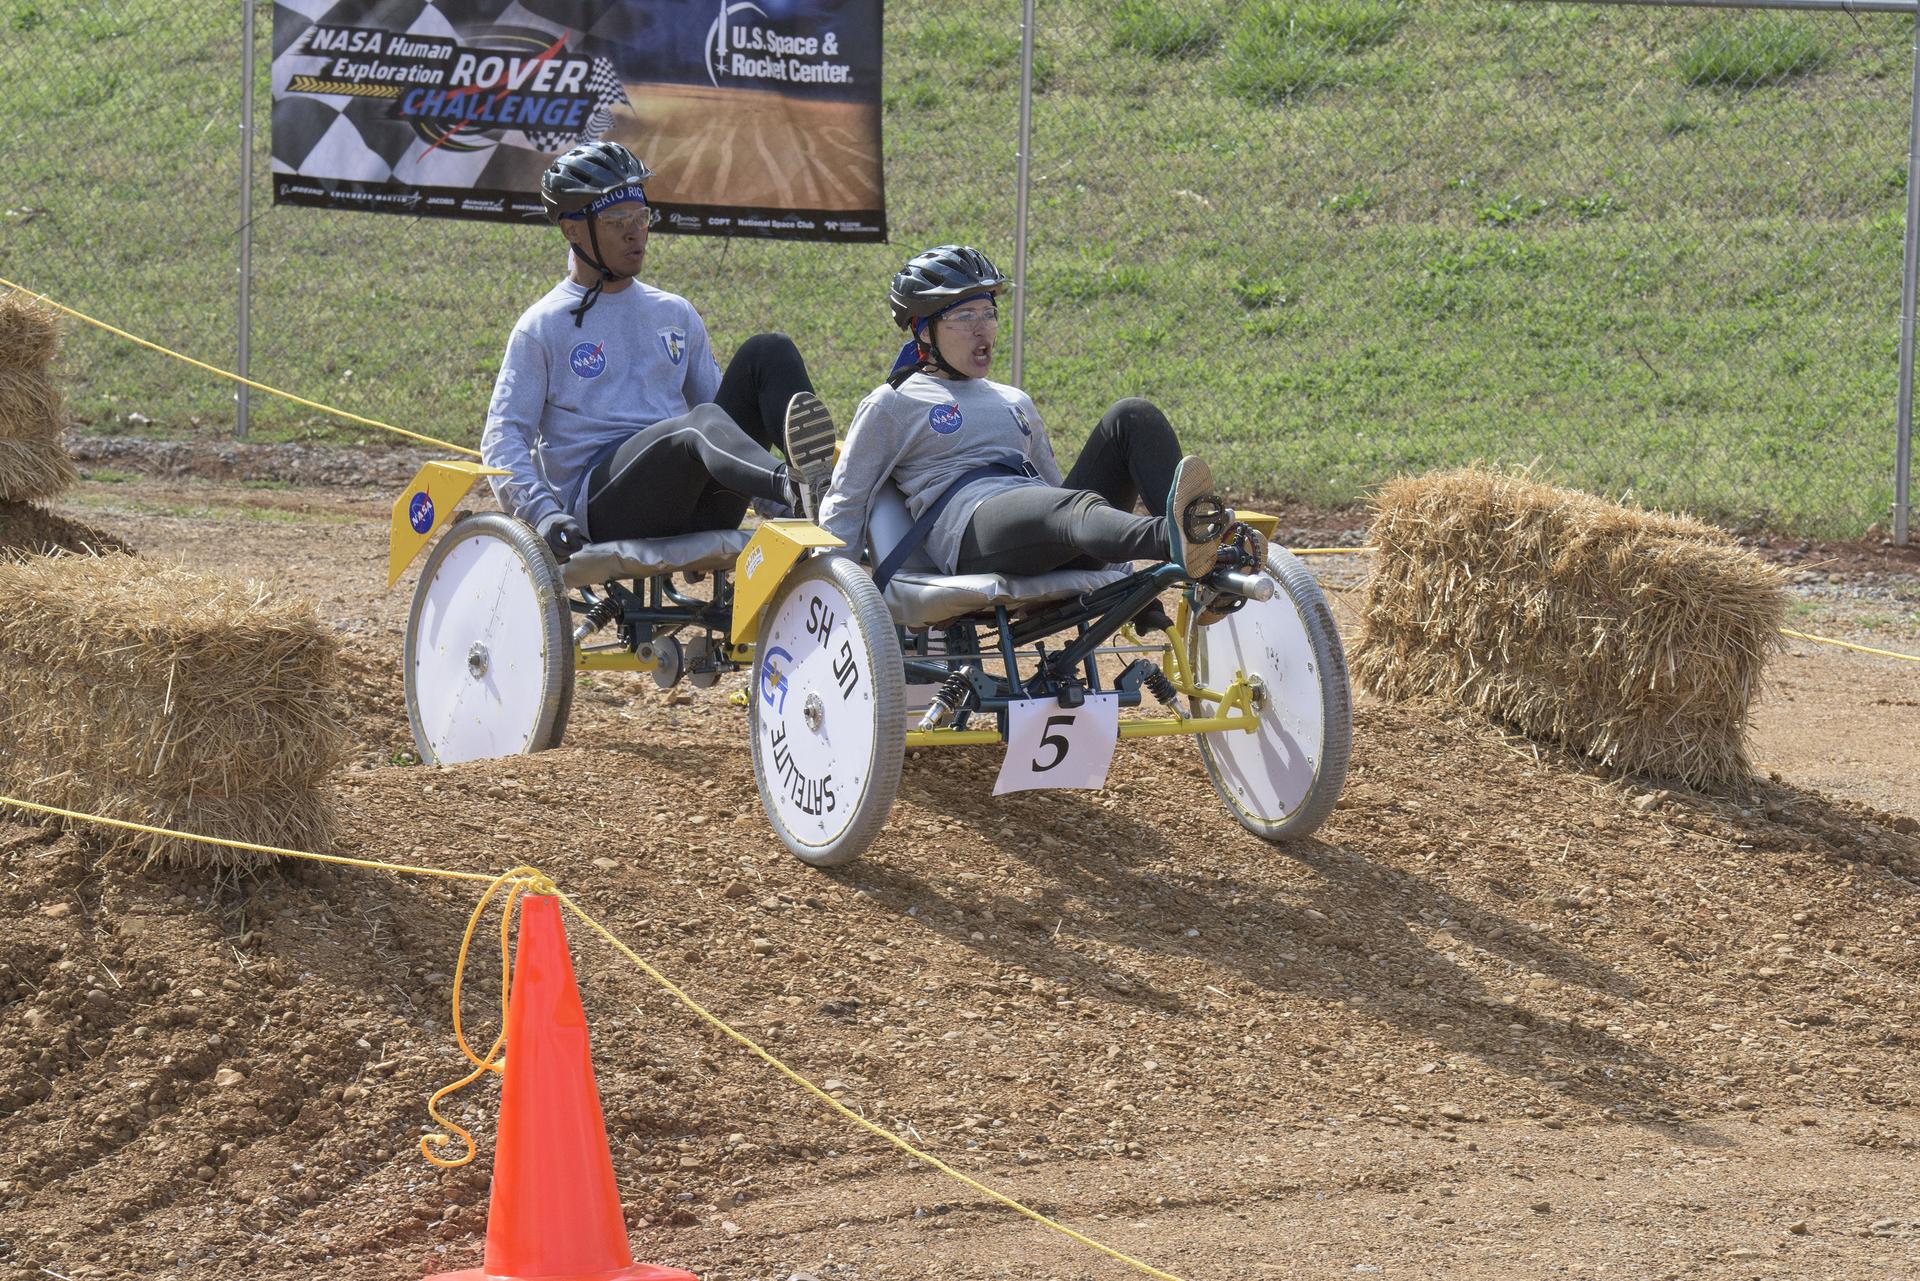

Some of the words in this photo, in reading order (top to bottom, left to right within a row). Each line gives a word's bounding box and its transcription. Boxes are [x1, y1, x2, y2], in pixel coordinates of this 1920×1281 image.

[310, 28, 384, 54] NASA
[386, 37, 453, 60] Human
[766, 30, 819, 58] Space
[822, 32, 839, 56] &
[332, 58, 445, 84] Exploration
[450, 54, 588, 93] ROVER
[732, 53, 788, 80] Rocket
[402, 88, 588, 126] CHALLENGE
[738, 218, 770, 228] National
[771, 219, 795, 230] Space
[796, 220, 815, 230] Club
[574, 353, 604, 369] NASA
[931, 411, 961, 426] NASA
[411, 500, 433, 527] NASA
[833, 640, 859, 700] UG
[1031, 715, 1076, 772] 5
[771, 721, 836, 816] SATELLITE
